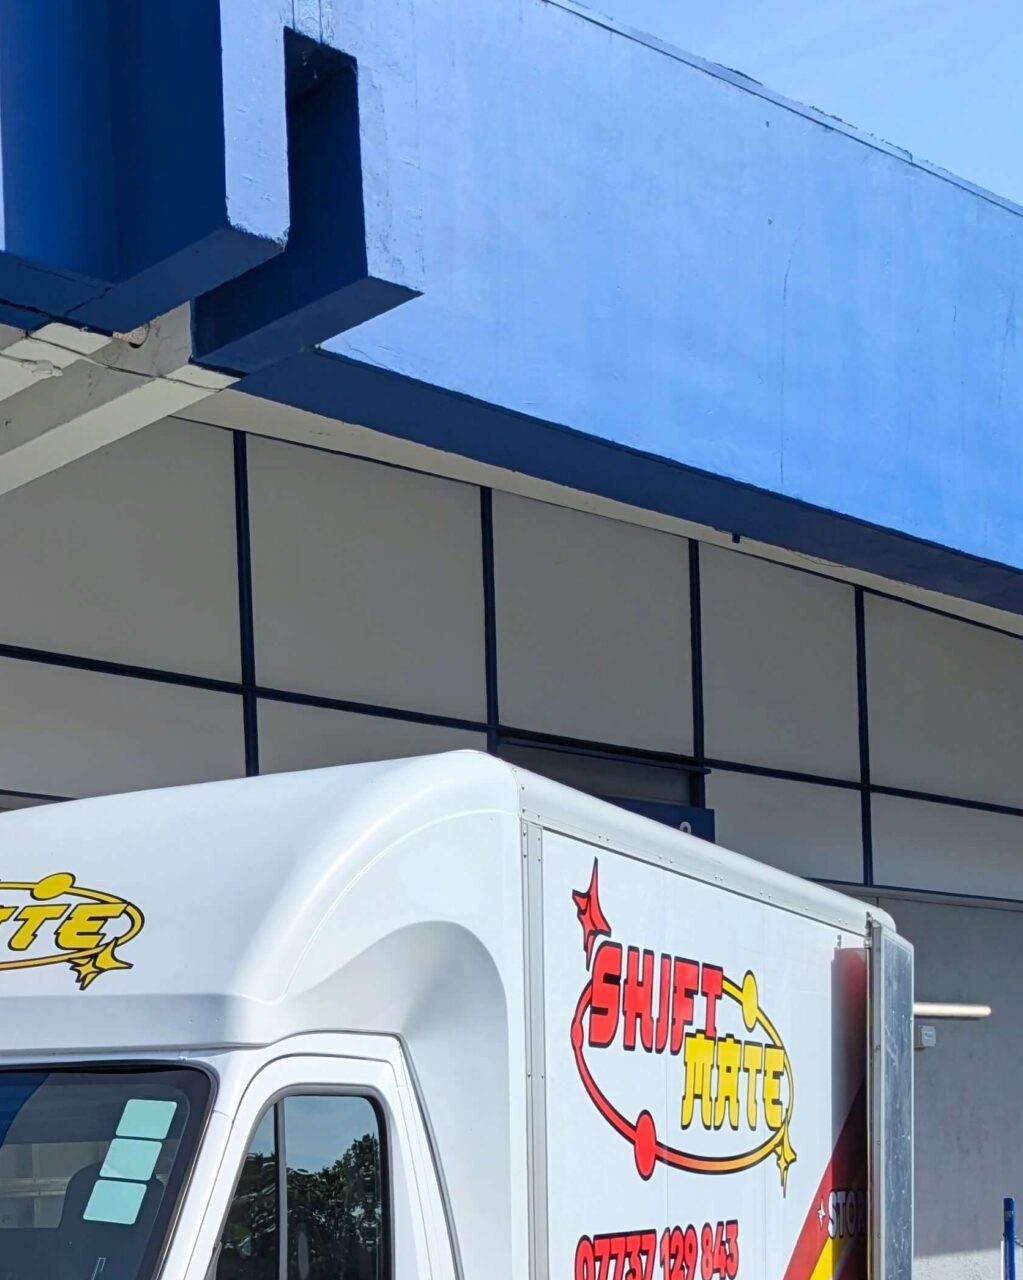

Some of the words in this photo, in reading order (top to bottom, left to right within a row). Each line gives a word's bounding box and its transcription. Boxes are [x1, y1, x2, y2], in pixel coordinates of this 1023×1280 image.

[588, 940, 724, 1055] SHIFT
[681, 1029, 785, 1130] MATE
[827, 1190, 866, 1239] STOR
